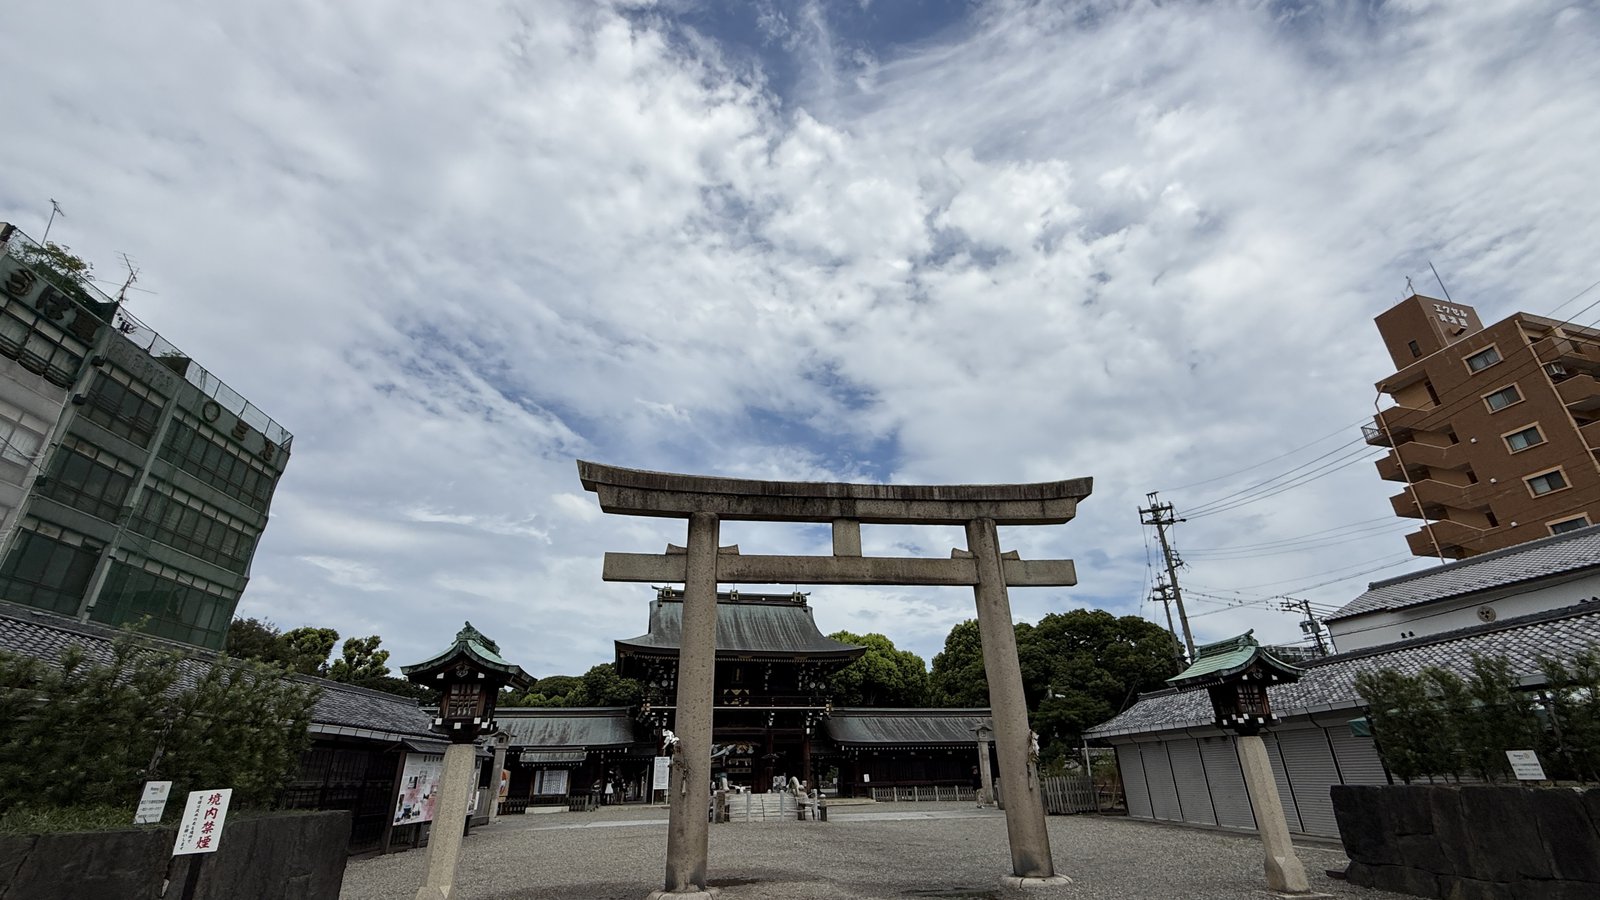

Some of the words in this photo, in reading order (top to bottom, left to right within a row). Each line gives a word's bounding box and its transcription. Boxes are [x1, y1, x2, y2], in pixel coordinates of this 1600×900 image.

[1433, 303, 1467, 318] エクセル
[195, 793, 223, 850] 境内禁煙
